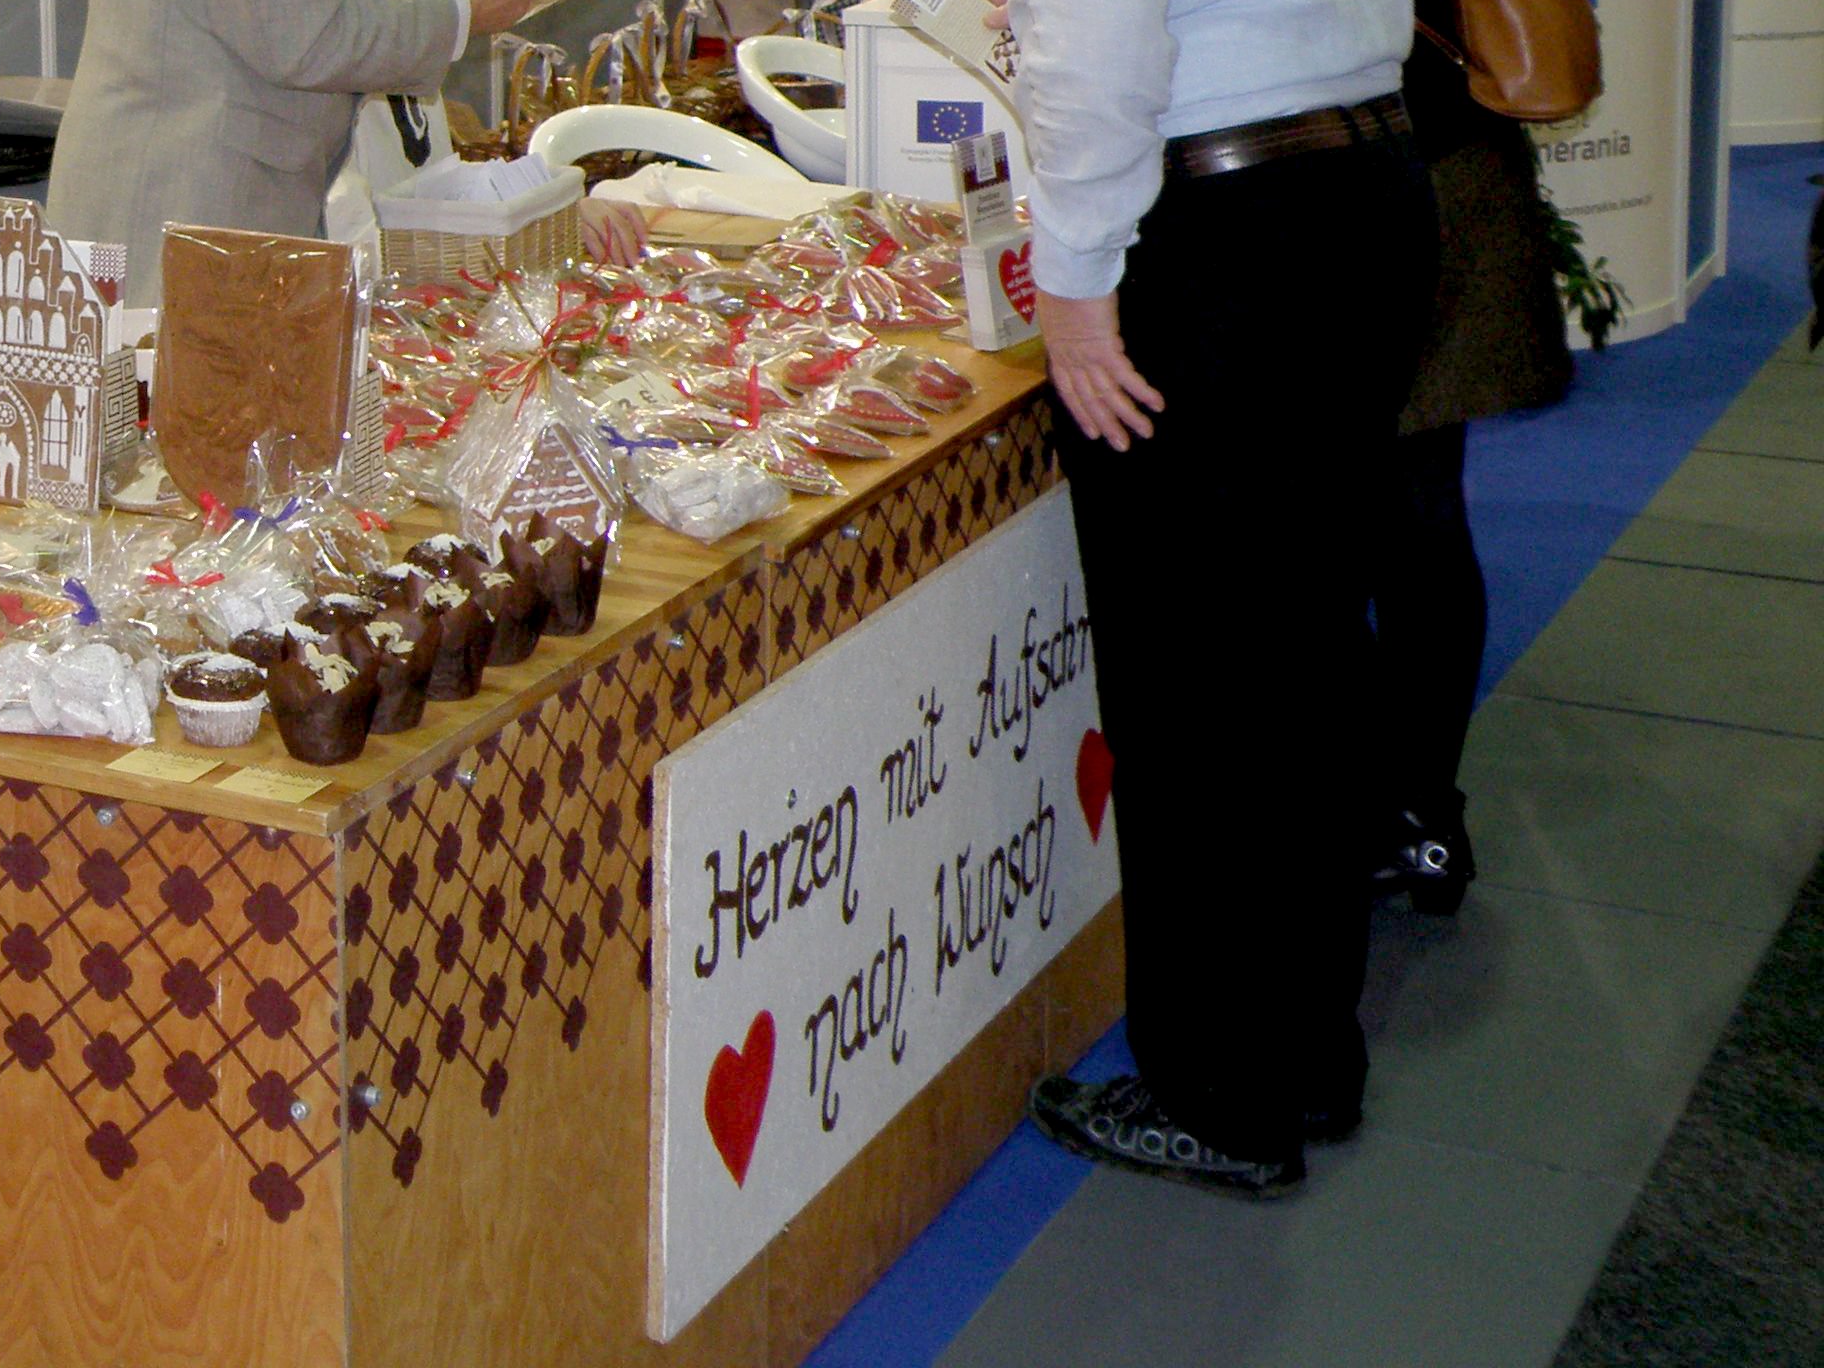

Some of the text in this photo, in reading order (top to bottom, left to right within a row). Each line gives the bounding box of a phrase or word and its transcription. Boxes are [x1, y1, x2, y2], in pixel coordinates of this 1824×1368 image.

[1536, 129, 1632, 164] merania
[694, 583, 1092, 979] Herzen mit Aufschr
[804, 777, 1056, 1132] nach Wunsch
